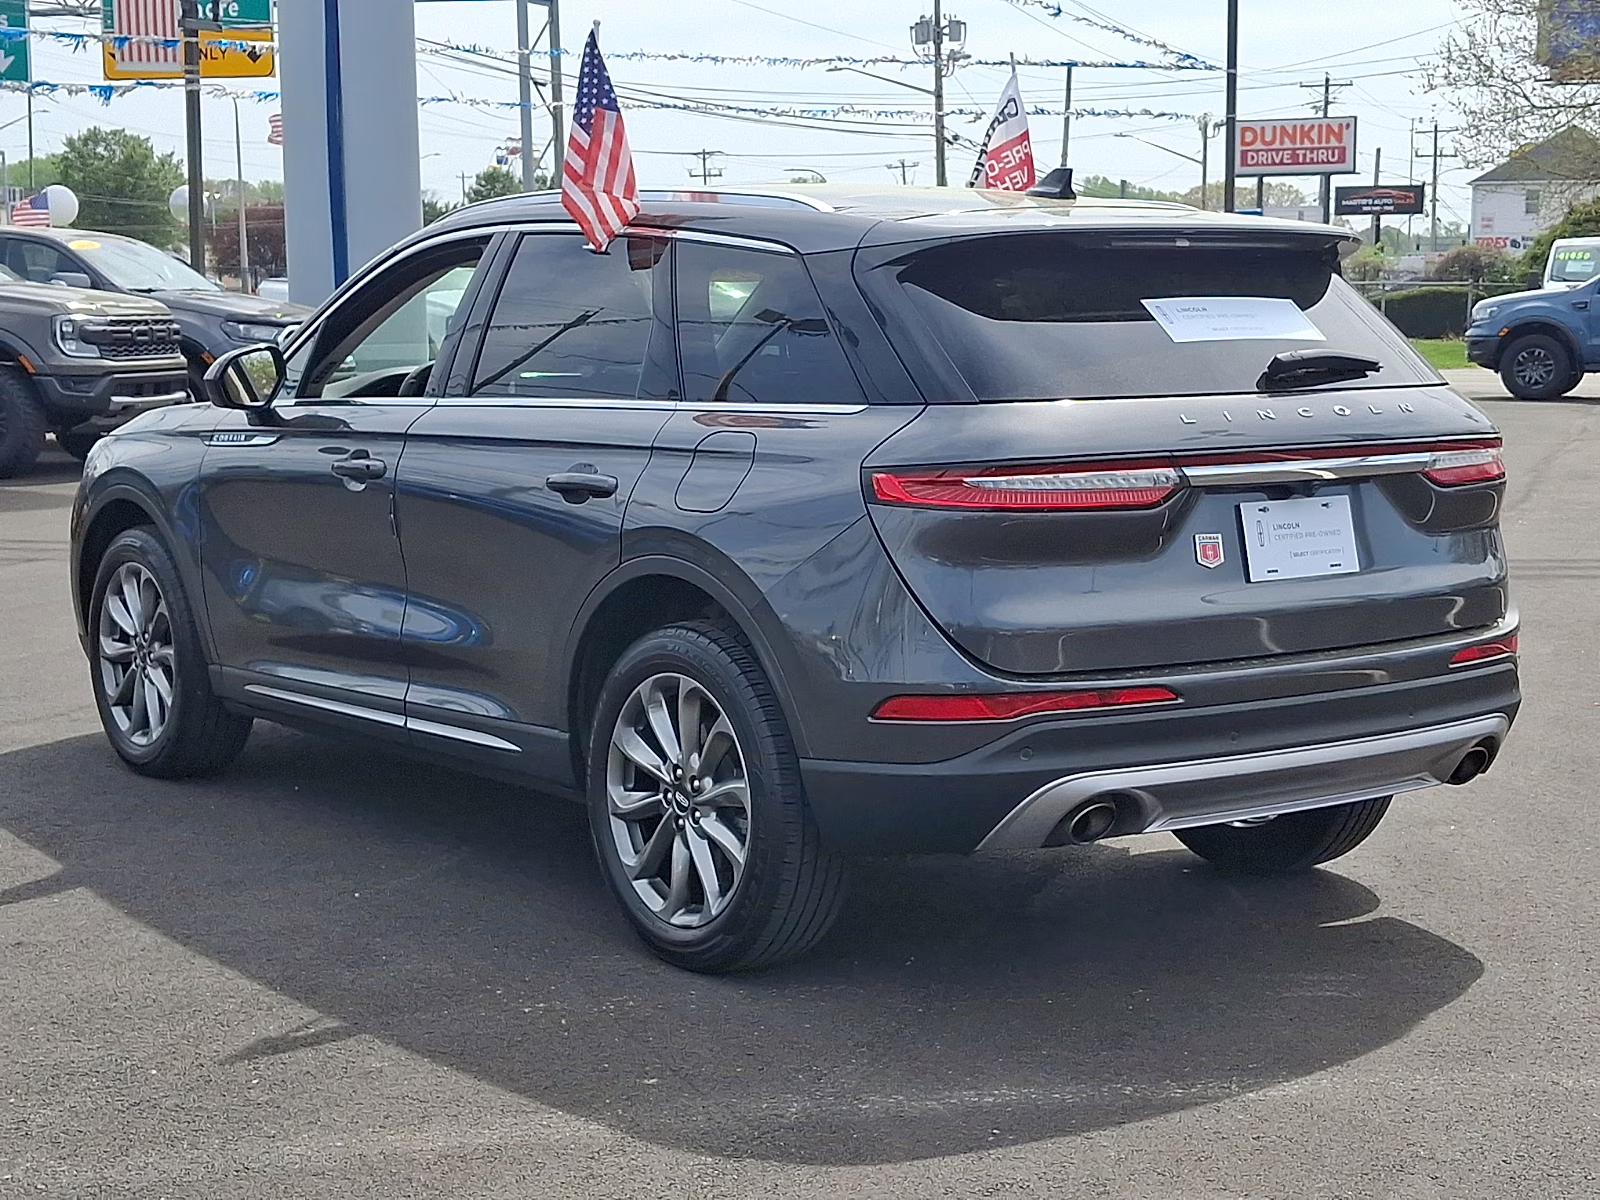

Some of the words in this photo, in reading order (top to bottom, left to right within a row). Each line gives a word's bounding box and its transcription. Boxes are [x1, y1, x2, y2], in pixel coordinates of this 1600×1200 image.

[199, 47, 228, 61] NLY
[1240, 122, 1350, 147] DUNKIN'
[1247, 151, 1292, 165] DRIVE
[1295, 148, 1339, 163] THRU
[1179, 402, 1414, 425] LINCOLN
[1272, 521, 1300, 531] LINCOLN
[1274, 532, 1304, 541] CERTIFIED
[1304, 529, 1342, 539] PRE-OWNED
